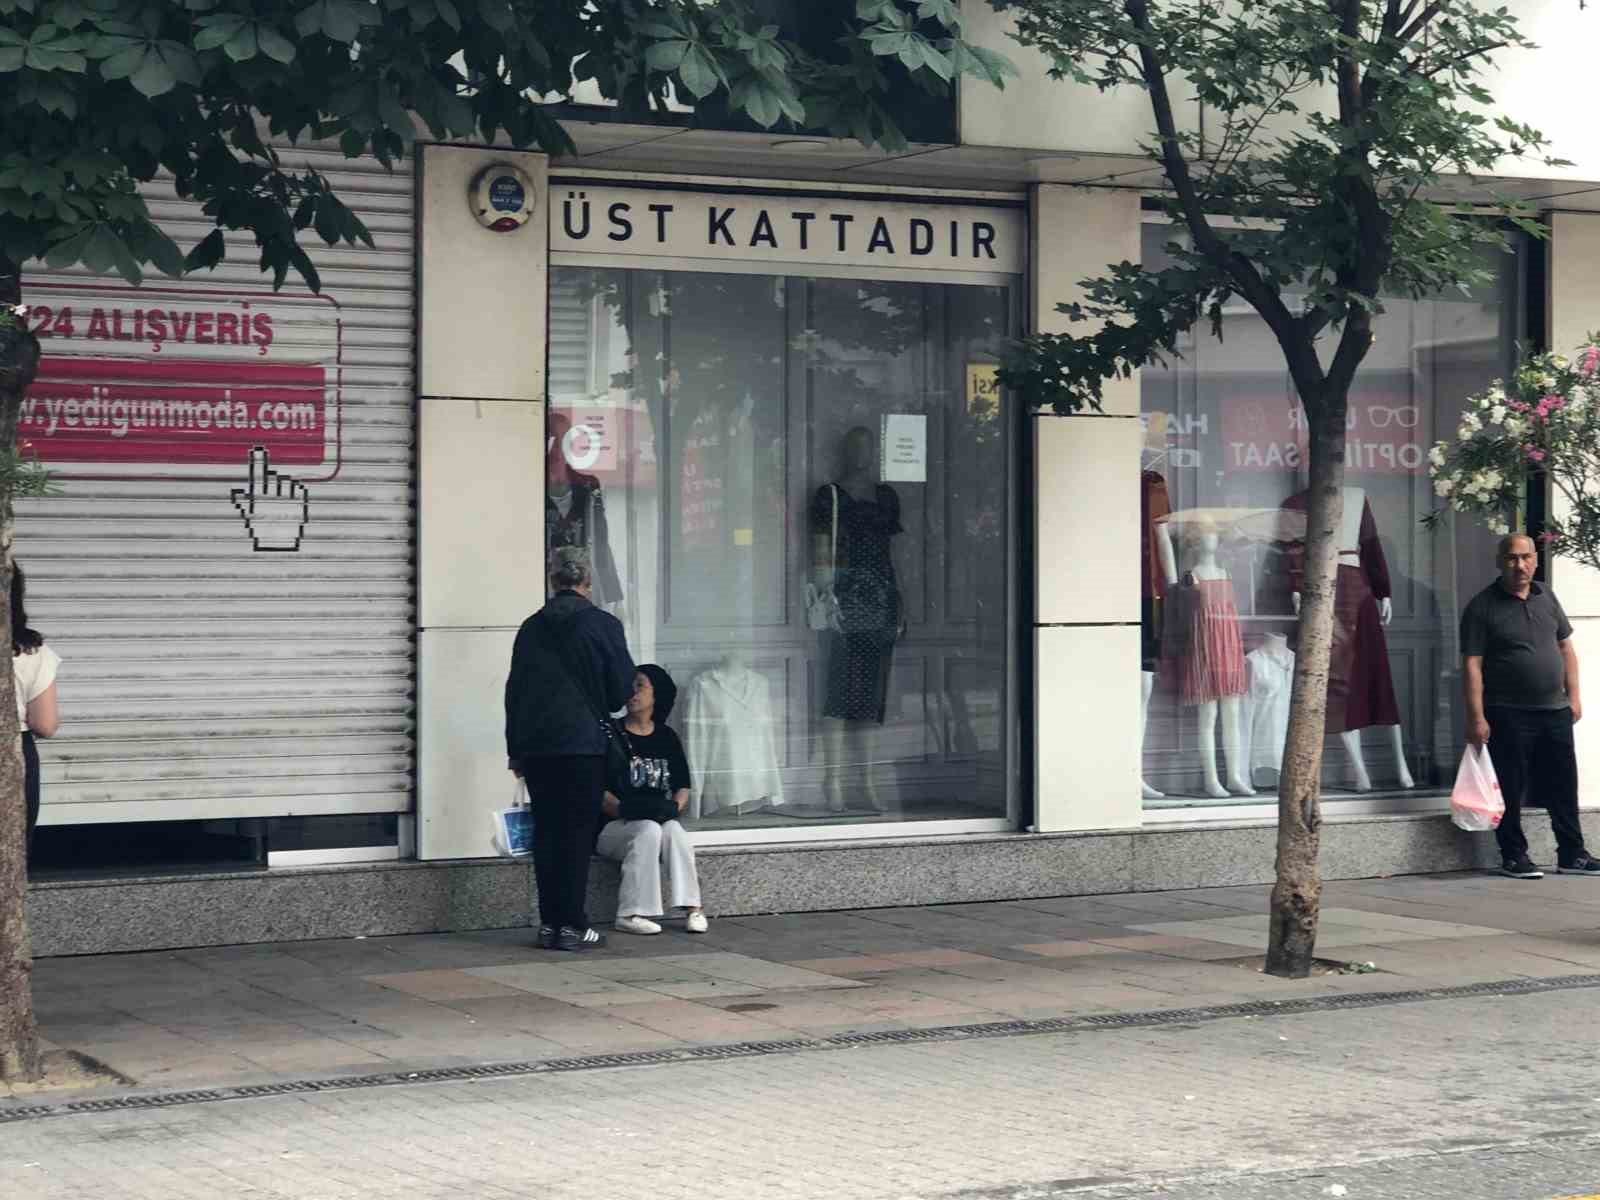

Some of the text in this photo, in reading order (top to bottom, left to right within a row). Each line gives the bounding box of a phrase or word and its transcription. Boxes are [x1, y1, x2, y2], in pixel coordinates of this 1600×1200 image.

[562, 191, 998, 259] ÜST KATTADIR
[87, 300, 274, 356] ALIŞVERİŞ
